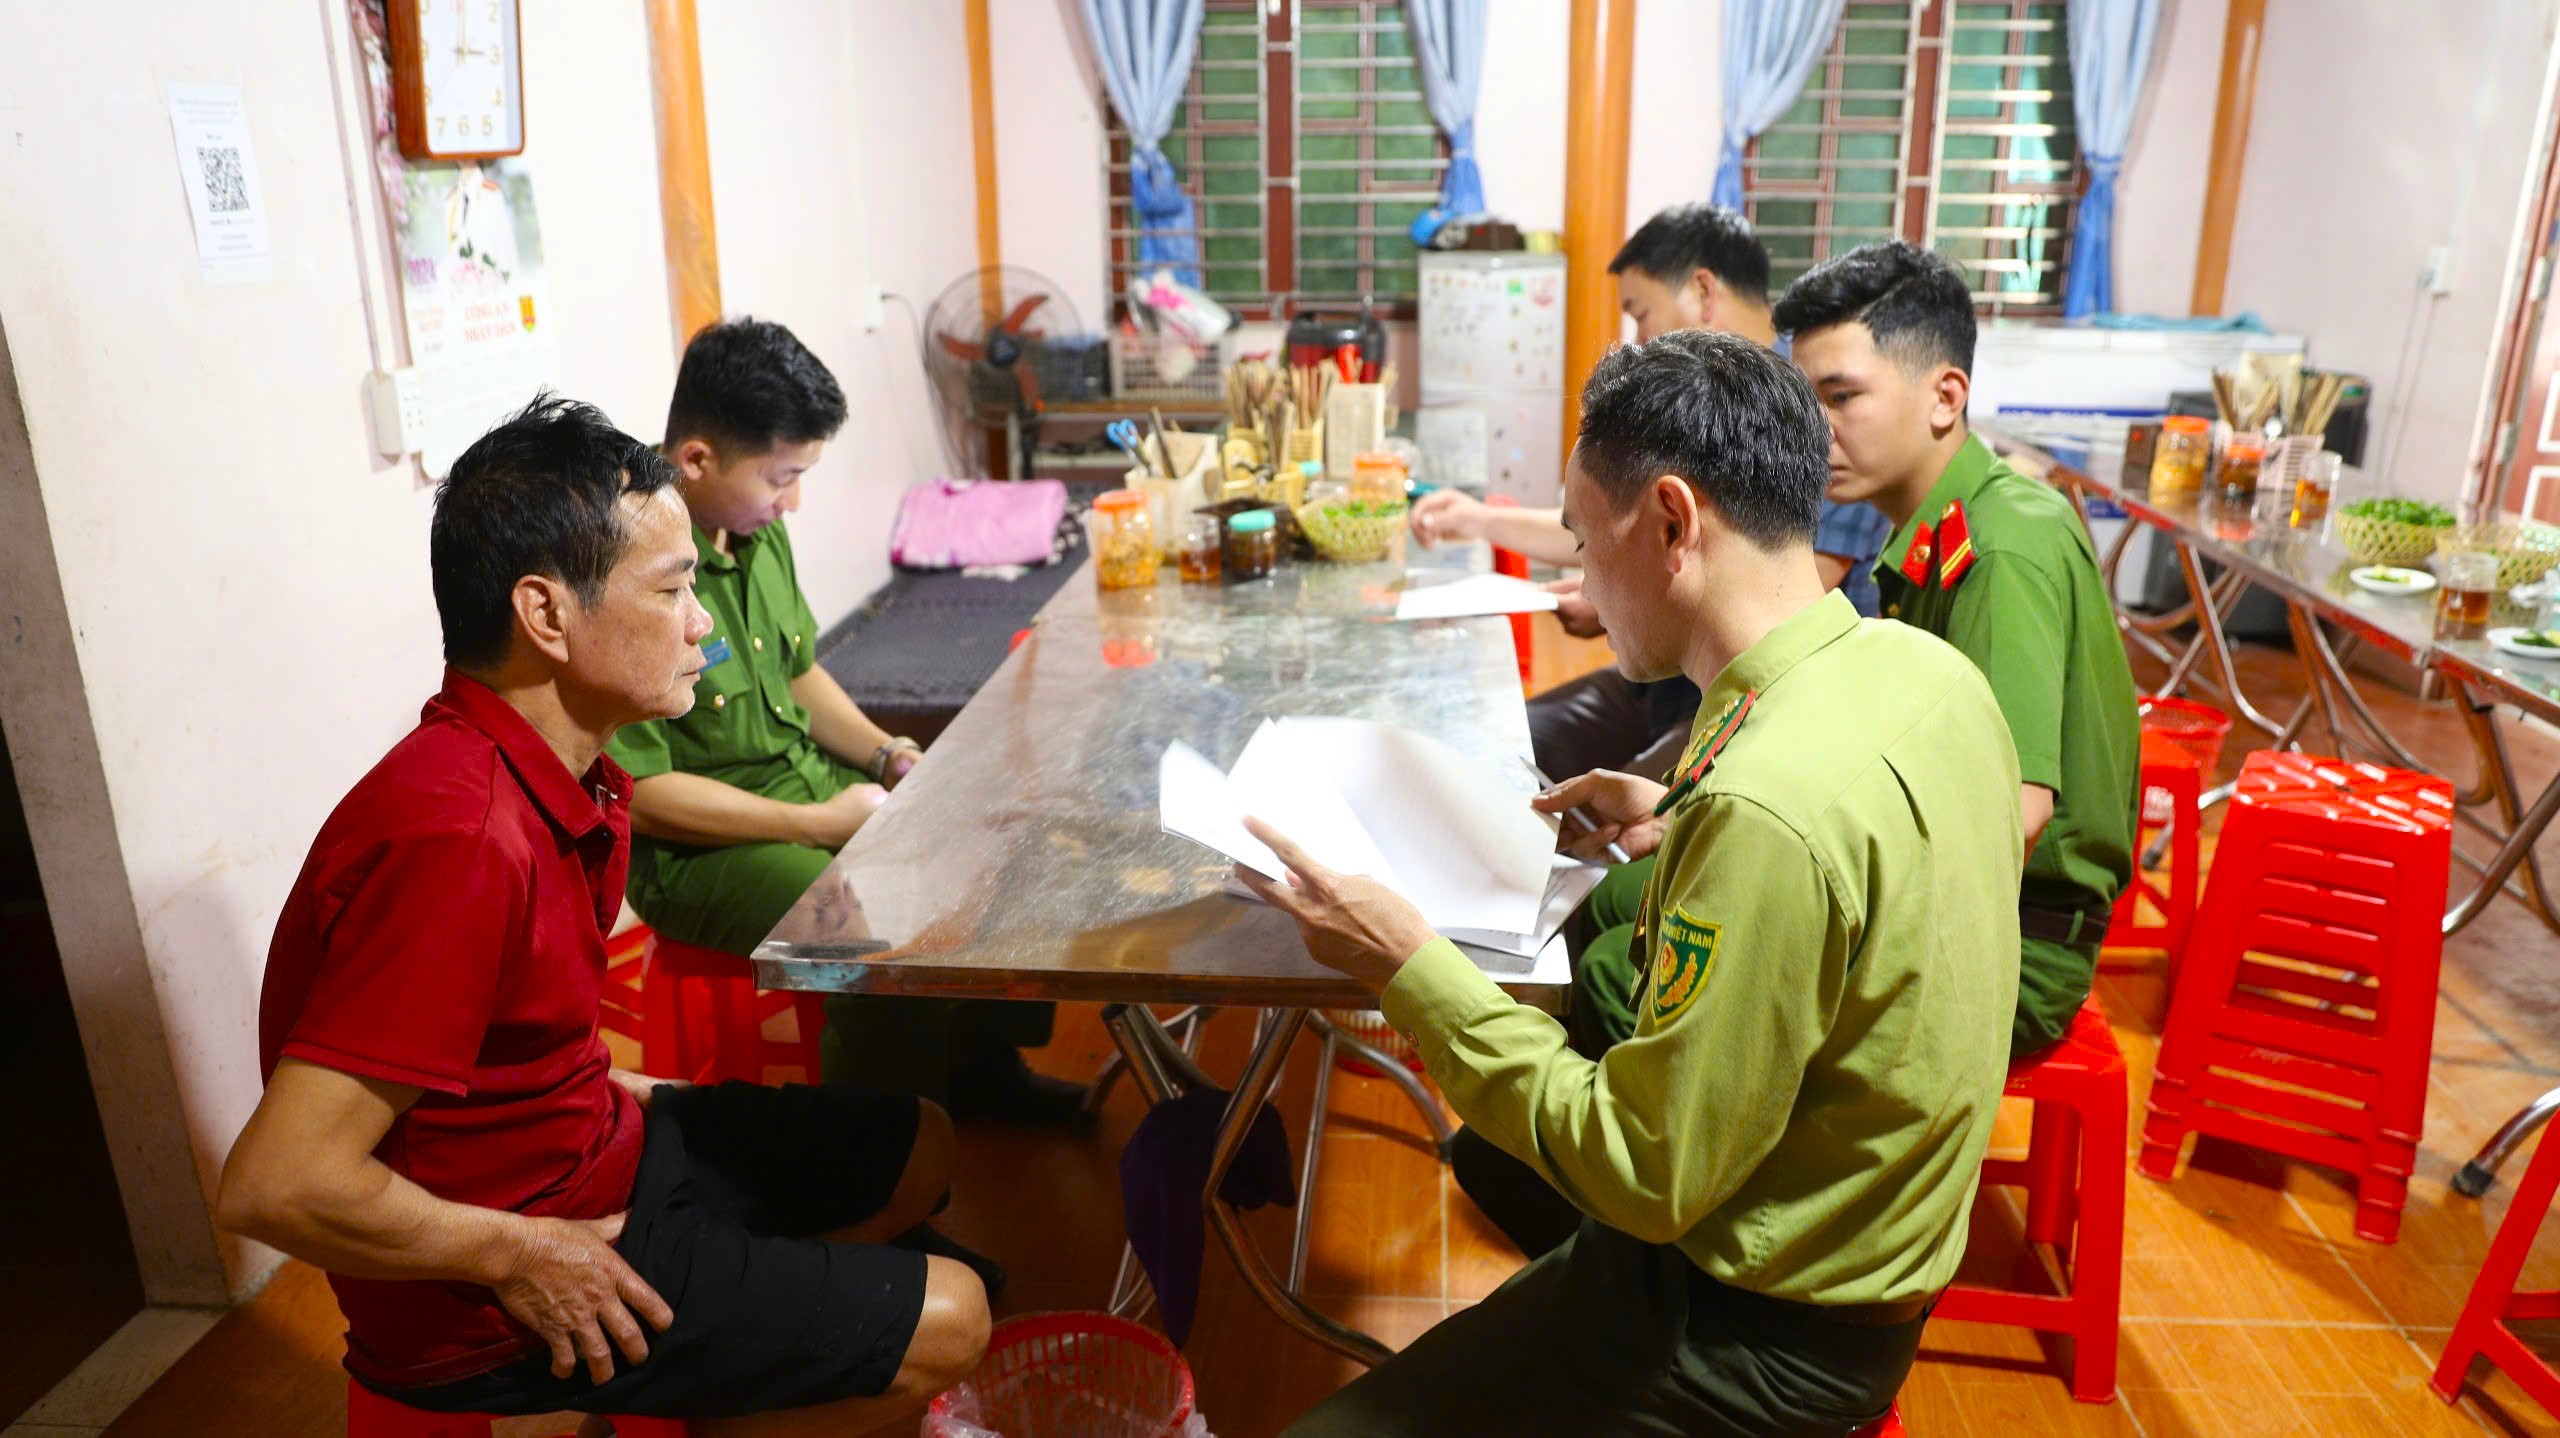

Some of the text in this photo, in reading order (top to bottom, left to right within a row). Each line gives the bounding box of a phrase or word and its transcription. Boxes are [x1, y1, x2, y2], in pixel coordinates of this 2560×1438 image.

[487, 1, 499, 23] 2
[488, 44, 501, 65] 3
[435, 114, 495, 137] 7 6 5
[1688, 929, 1713, 950] NAM
